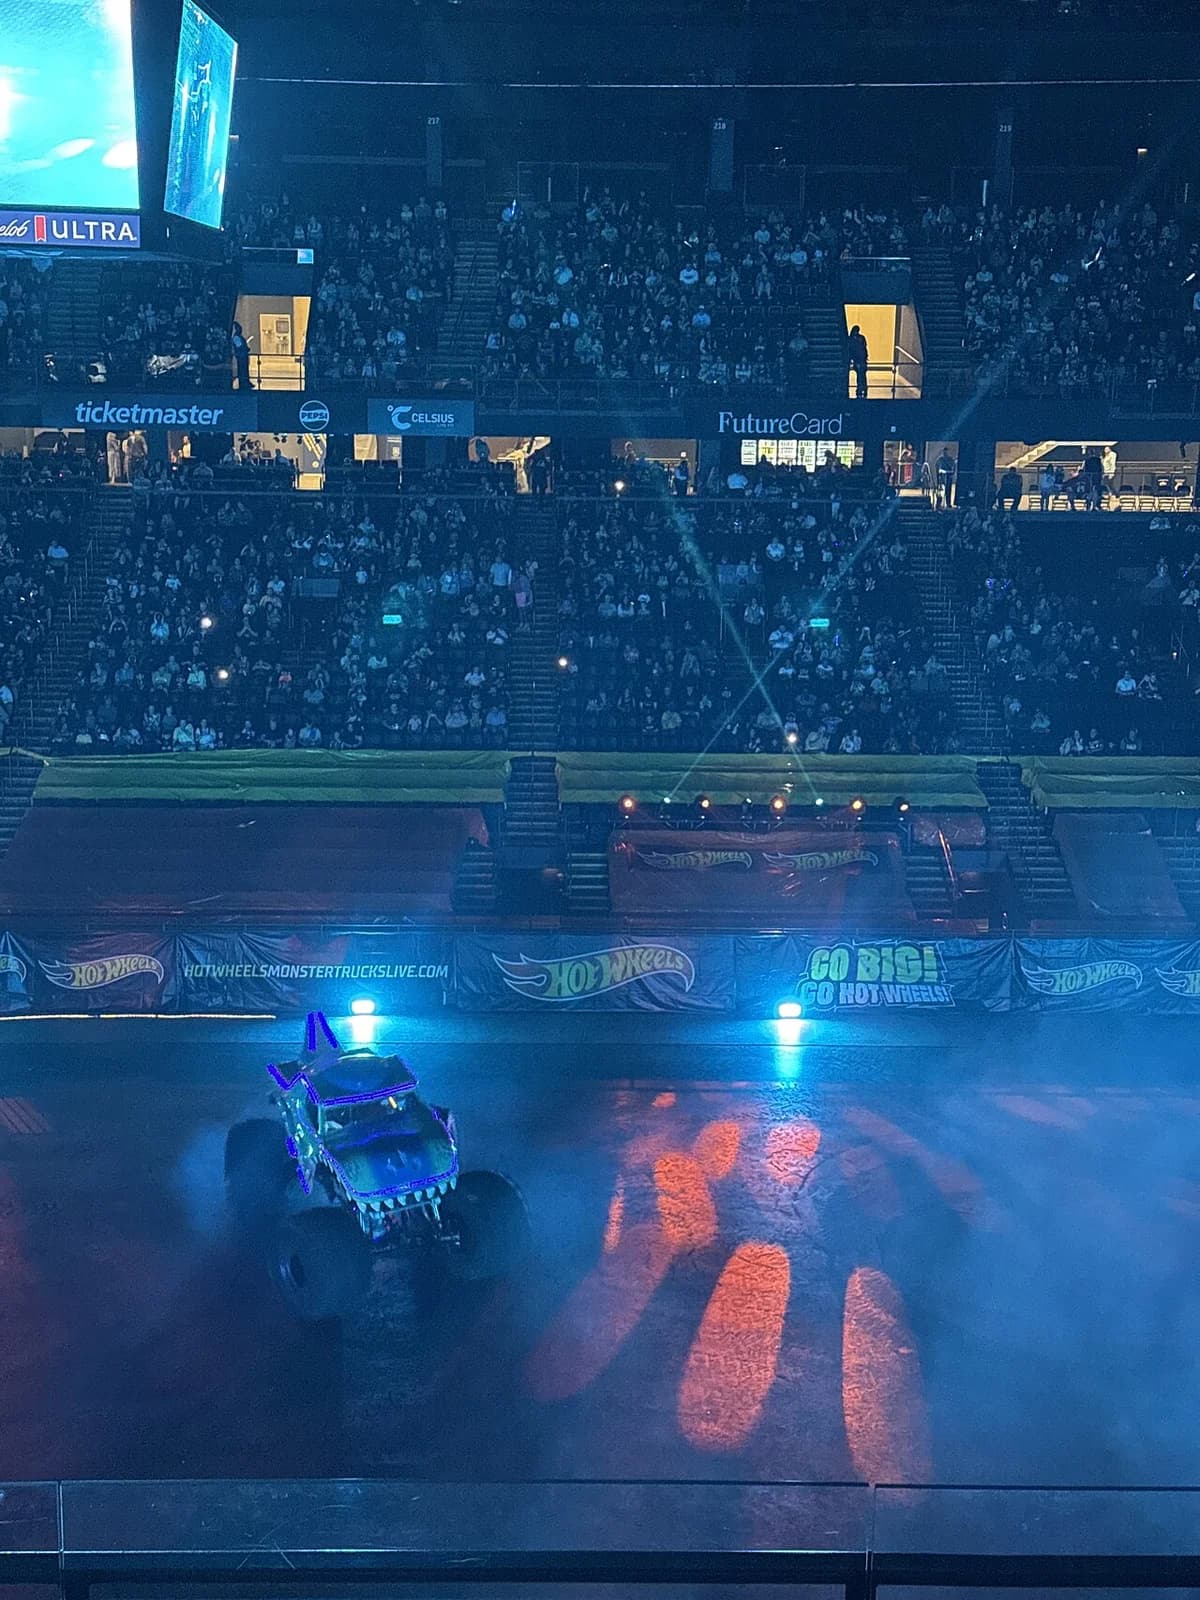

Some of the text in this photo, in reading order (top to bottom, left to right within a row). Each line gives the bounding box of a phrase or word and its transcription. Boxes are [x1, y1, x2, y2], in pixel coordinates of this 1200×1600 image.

[52, 219, 136, 242] ULTRA
[75, 401, 223, 426] ticketmaster
[301, 405, 328, 419] PEPSI
[411, 413, 455, 424] CELSIUS
[718, 411, 842, 435] FutureCard
[184, 964, 449, 979] HOTWHEELSMONSTERTRUCKSLIVE.COM
[810, 945, 938, 983] GO BIG!
[71, 965, 105, 987] HOT
[544, 960, 599, 997] HOT
[800, 981, 834, 1005] GO
[839, 982, 881, 1004] HOT
